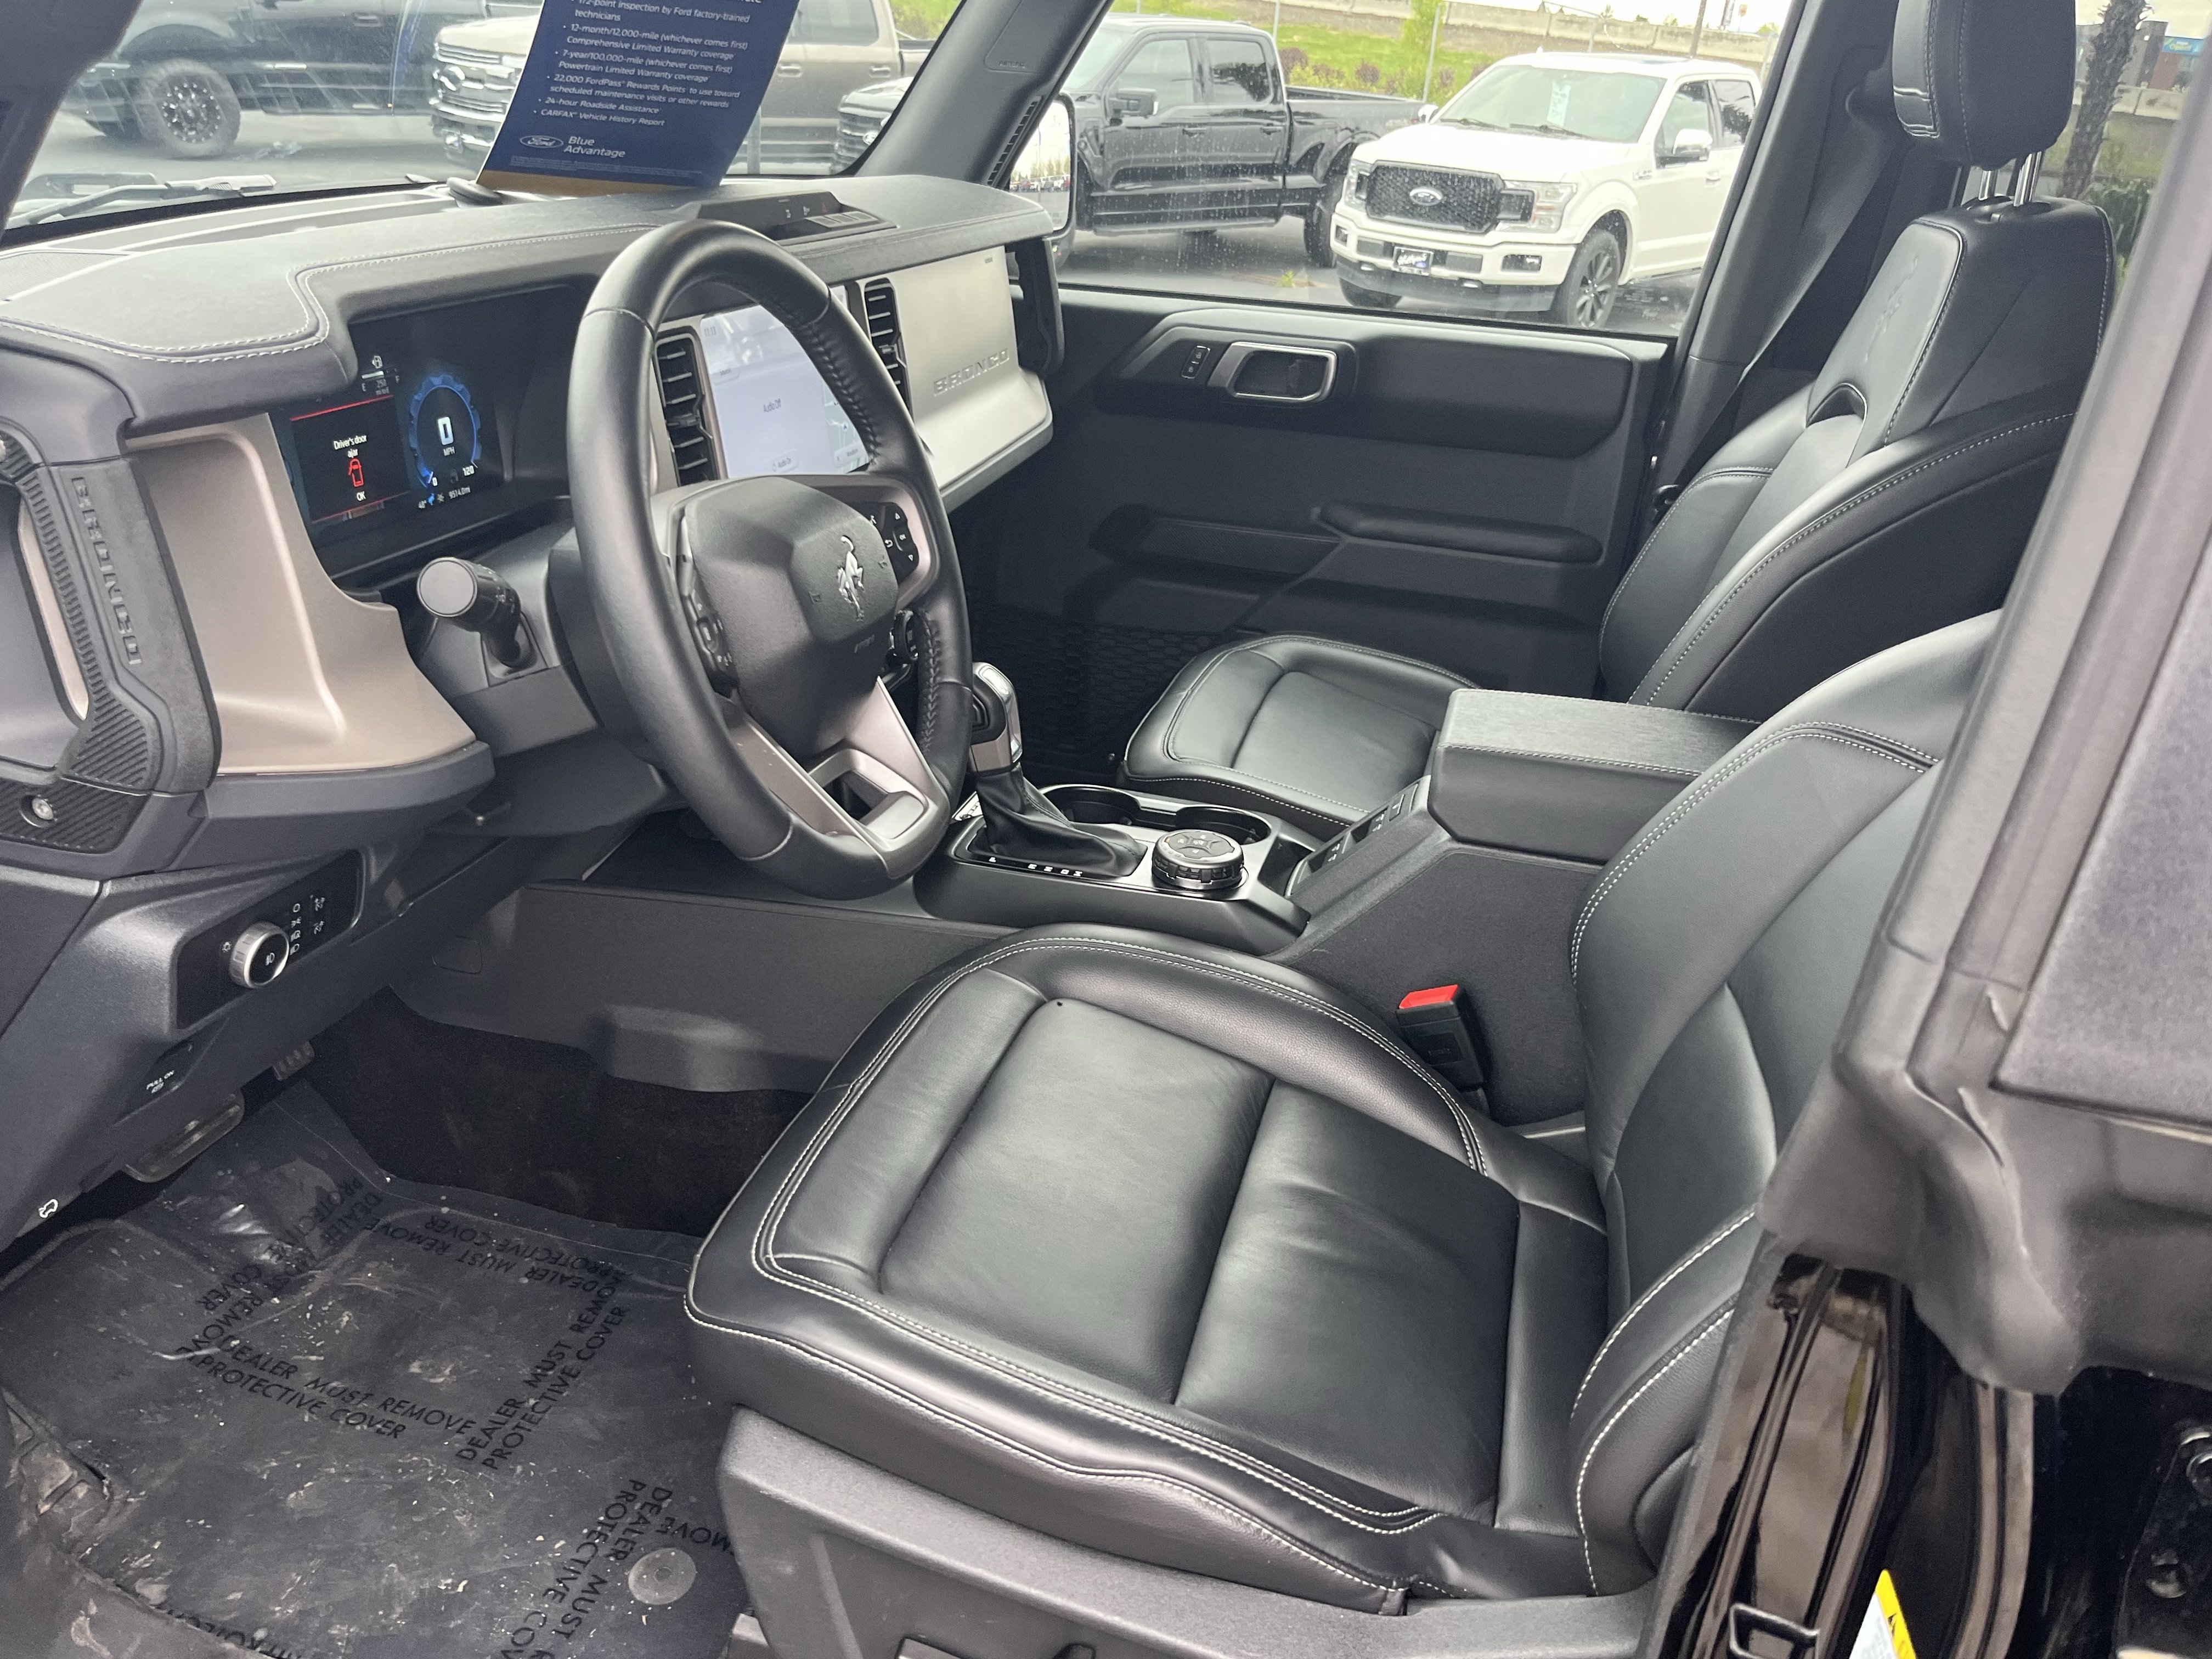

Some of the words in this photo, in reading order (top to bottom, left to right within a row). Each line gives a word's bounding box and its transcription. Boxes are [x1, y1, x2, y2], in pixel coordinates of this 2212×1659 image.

[575, 9, 620, 21] technicians
[618, 1, 659, 13] inspection
[662, 6, 672, 15] by
[673, 7, 692, 16] Ford
[693, 9, 750, 22] factory-trained
[567, 36, 630, 49] Comprehensive
[632, 43, 661, 52] Limited
[663, 46, 698, 57] Warranty
[661, 33, 702, 44] (whichever
[731, 41, 748, 50] first)
[558, 61, 603, 72] Powertrain
[605, 65, 635, 75] Limited
[637, 69, 673, 80] Warranty
[645, 58, 687, 69] (whichever
[715, 65, 732, 74] first)
[550, 86, 592, 95] scheduled
[594, 90, 645, 100] maintenance
[699, 100, 729, 108] rewards
[554, 74, 584, 83] 22,000
[627, 81, 660, 91] Rewards
[662, 84, 686, 93] Points
[714, 89, 740, 98] toward
[545, 97, 578, 106] 24-hour
[580, 100, 617, 110] Roadside
[618, 104, 659, 114] Assistance
[579, 112, 607, 121] Vehicle
[609, 115, 636, 124] History
[638, 117, 665, 126] Report
[563, 145, 625, 158] Advantage
[568, 136, 595, 146] Blue
[934, 348, 1009, 397] BRONCO
[438, 417, 454, 445] 0
[334, 438, 354, 450] Driver's
[354, 436, 366, 444] door
[348, 449, 358, 458] ajar
[443, 447, 455, 456] MPH
[462, 465, 475, 476] 120
[357, 491, 366, 501] OK
[72, 477, 142, 664] BRONCO
[364, 1217, 452, 1256] REMOVE
[425, 1215, 490, 1247] COVER
[456, 1249, 517, 1273] MUST
[524, 1265, 601, 1293] DEALER
[455, 1397, 525, 1461] DEALER
[522, 1340, 572, 1388] MUST
[570, 1268, 633, 1333] REMOVE
[195, 1353, 326, 1414] PROTECTIVE
[329, 1408, 406, 1439] COVER
[221, 1335, 299, 1379] DEALER
[304, 1378, 375, 1406] MUST
[379, 1396, 477, 1437] REMOVE
[482, 1365, 581, 1470] PROTECTIVE
[576, 1306, 631, 1363] COVER
[604, 1487, 673, 1561] DEALER
[541, 1479, 648, 1604] PROTECTIVE
[551, 1573, 608, 1640] MUST
